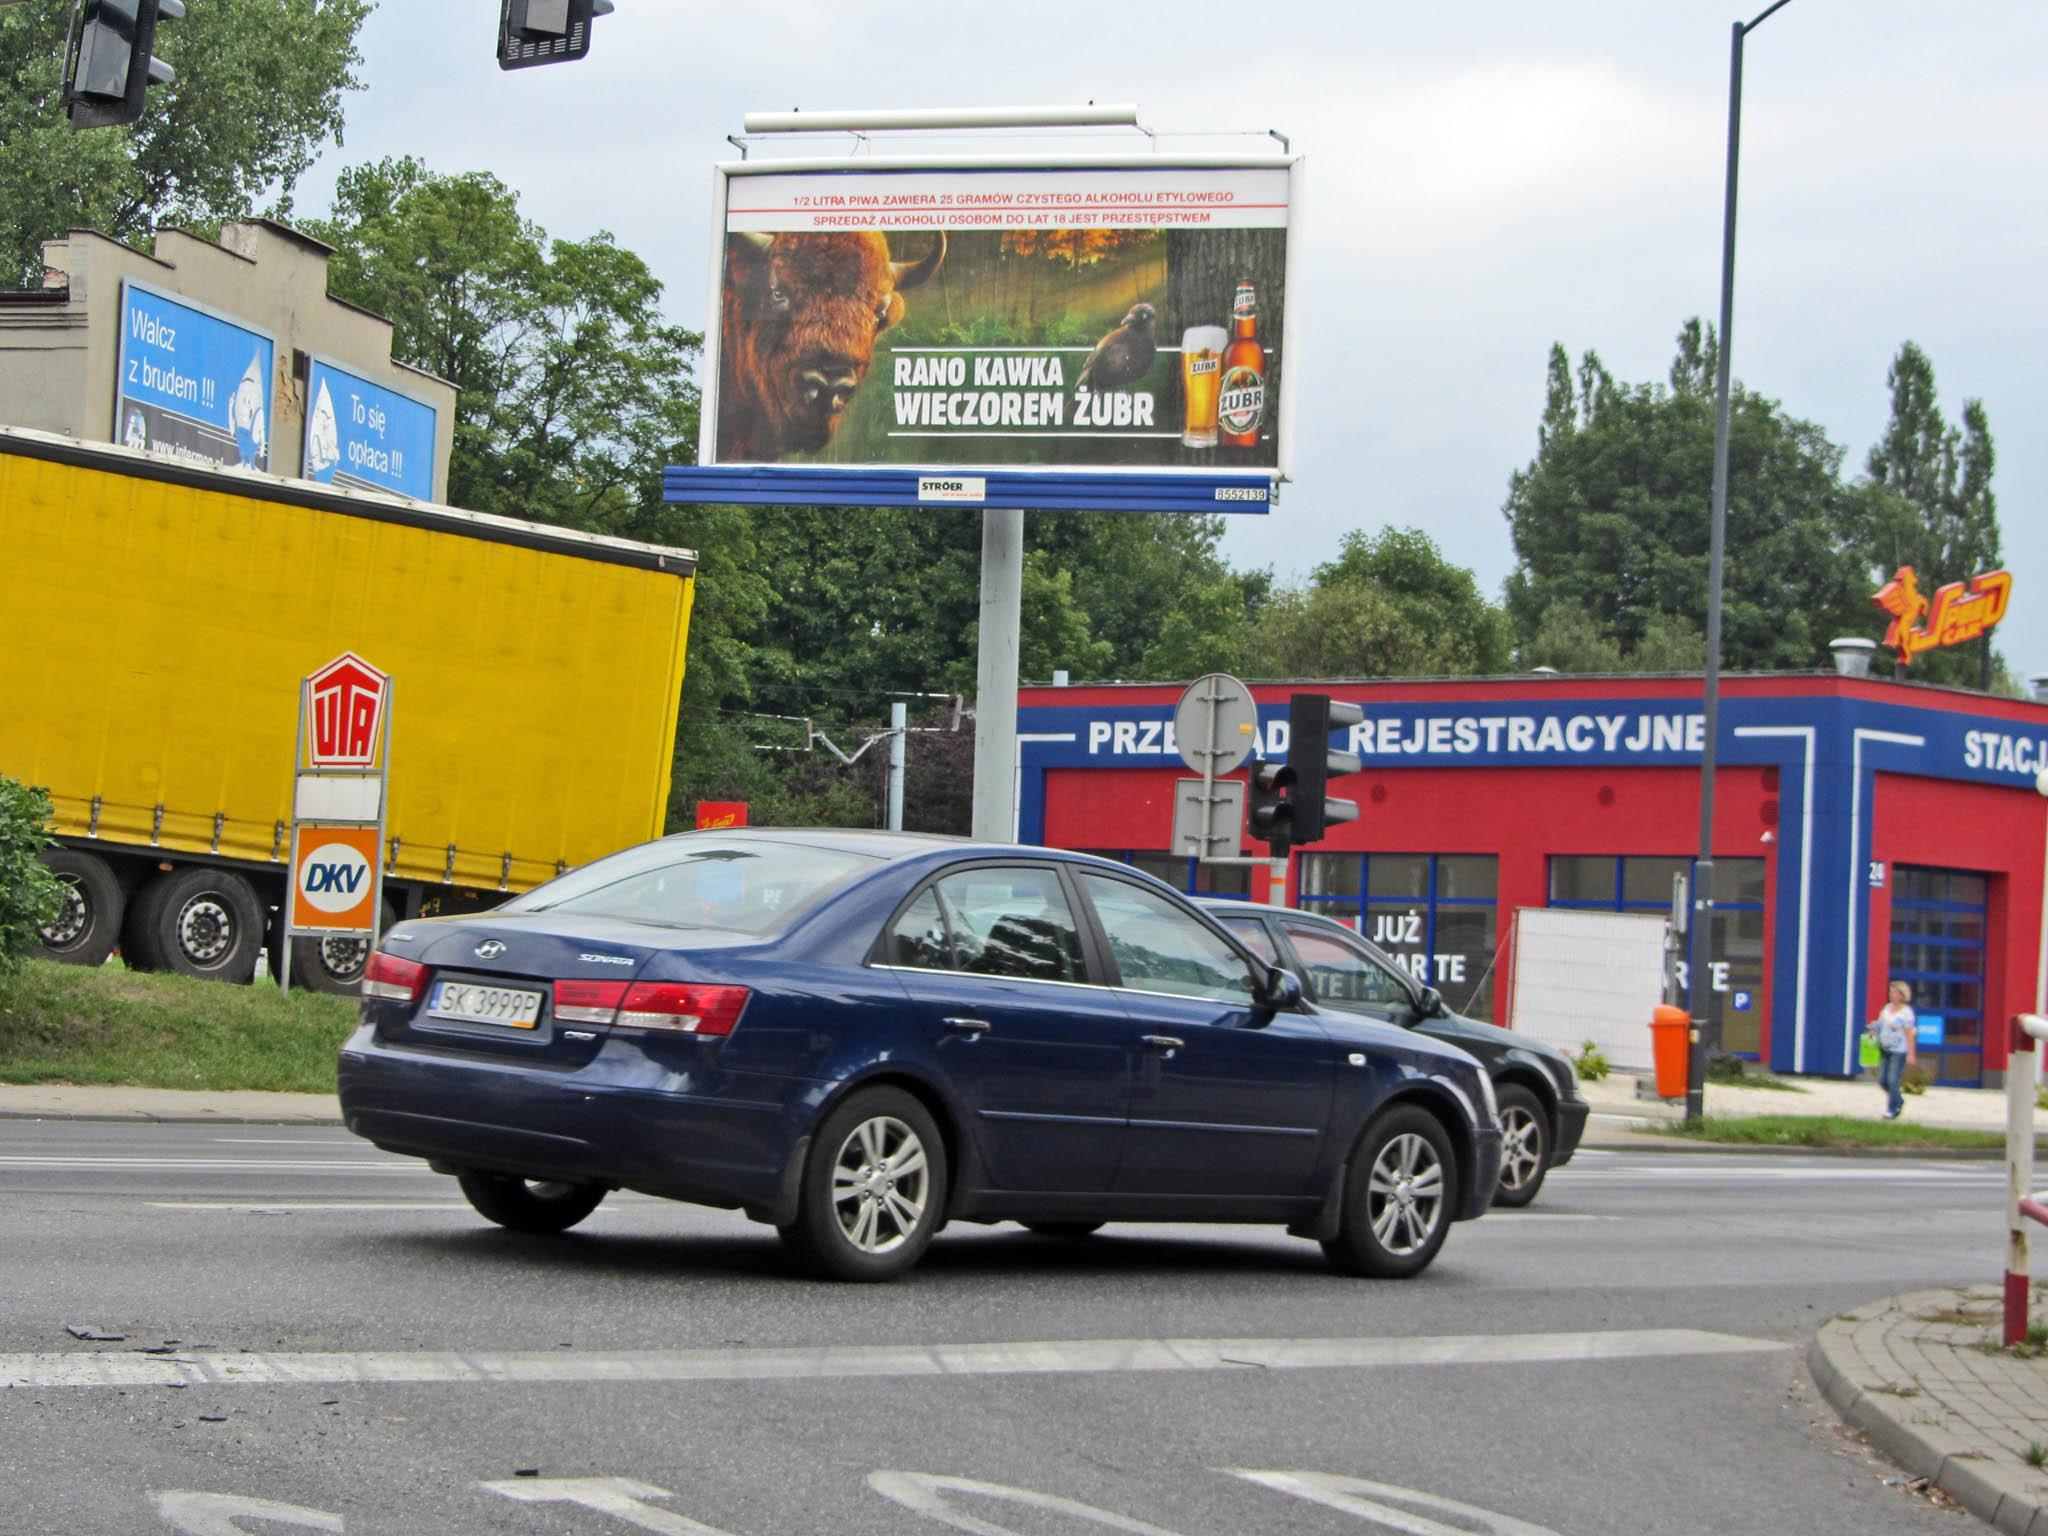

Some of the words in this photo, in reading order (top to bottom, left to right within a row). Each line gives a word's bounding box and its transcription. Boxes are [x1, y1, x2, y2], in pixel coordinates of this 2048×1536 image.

[793, 196, 810, 207] 1/2
[813, 195, 846, 206] LITRA
[849, 194, 879, 206] PIWA
[882, 194, 936, 206] ZAWIERA
[940, 194, 953, 205] 25
[956, 192, 1013, 205] GRAMÓW
[1016, 192, 1082, 204] CZYSTEGO
[1085, 192, 1153, 203] ALKOHOLU
[1156, 191, 1235, 203] ETYLOWEGO
[813, 213, 877, 226] SPRZEDAŻ
[879, 214, 946, 226] ALKOHOLU
[949, 213, 1003, 225] OSOBOM
[1005, 213, 1025, 225] DO
[1027, 213, 1049, 225] LAT
[1053, 213, 1066, 225] 18
[1068, 213, 1099, 224] JEST
[1101, 212, 1211, 225] PRZESTĘPSTWEM
[131, 307, 176, 352] Walcz
[128, 359, 139, 383] z
[142, 356, 198, 403] brudem
[201, 376, 215, 408] !!!
[893, 357, 967, 387] RANO
[973, 357, 1064, 387] KAWKA
[351, 394, 366, 425] To
[368, 403, 386, 440] się
[893, 391, 1064, 426] WIECZOREM
[1072, 385, 1155, 427] ŻUBR
[391, 449, 404, 479] !!!
[1217, 488, 1265, 500] 8552139
[314, 662, 380, 758] UTA
[1348, 714, 1707, 754] REJESTRACYJNE
[1963, 729, 2048, 776] STACJ
[304, 862, 367, 894] DKV
[1372, 908, 1422, 944] JUŻ
[441, 985, 471, 1012] SK
[473, 989, 537, 1020] 3999P
